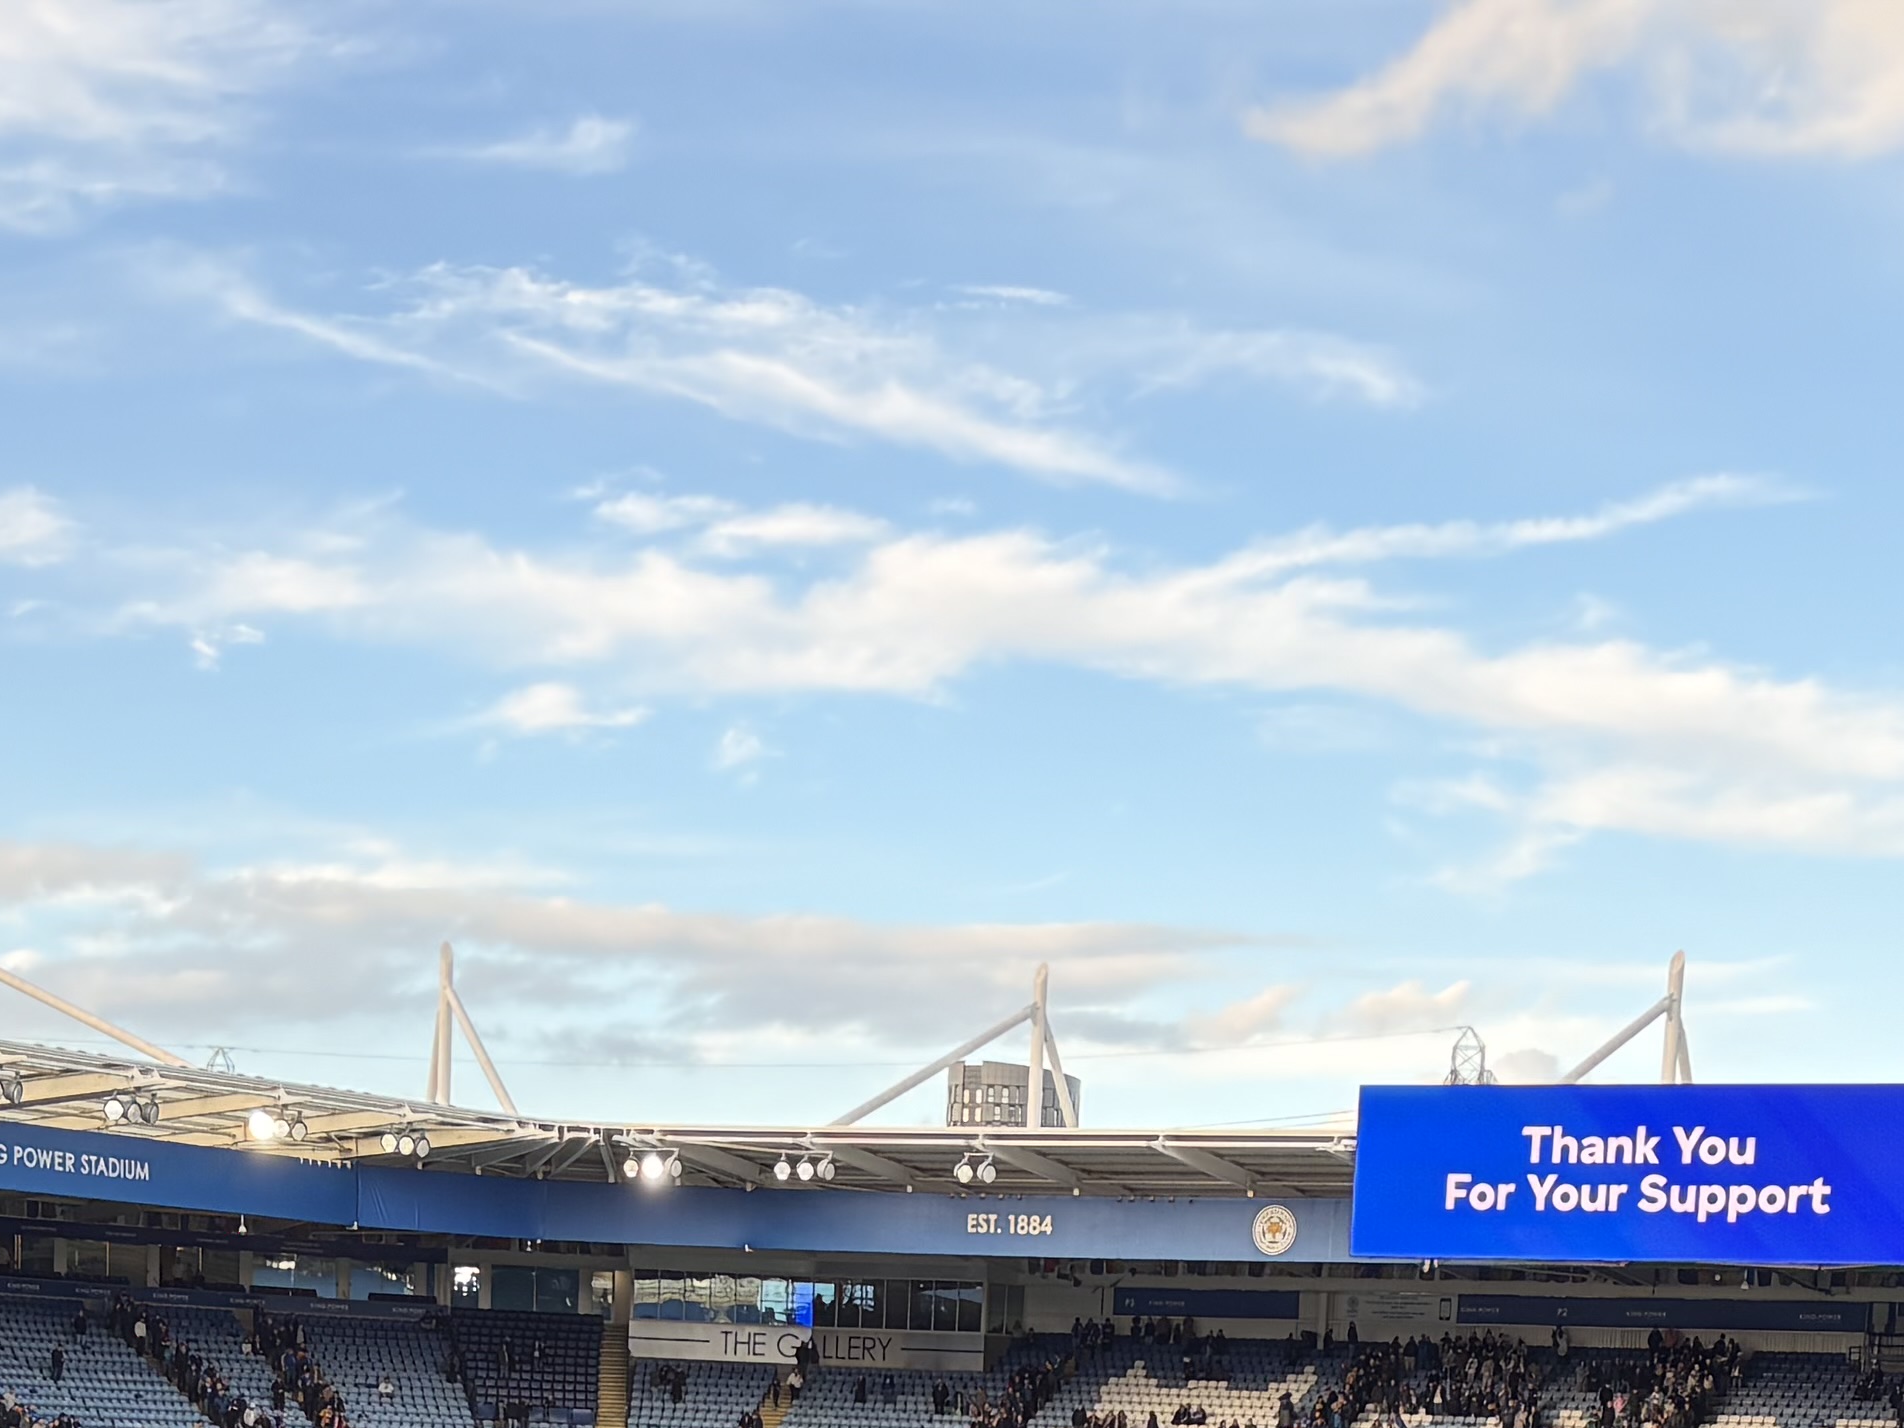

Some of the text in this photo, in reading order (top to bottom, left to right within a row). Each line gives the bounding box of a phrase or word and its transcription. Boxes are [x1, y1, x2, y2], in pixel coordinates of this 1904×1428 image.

[1521, 1125, 1757, 1165] Thank You
[13, 1146, 75, 1173] POWER
[80, 1154, 150, 1181] STADIUM
[1445, 1173, 1832, 1223] For Your Support
[967, 1214, 1053, 1236] EST. 1884
[721, 1330, 765, 1360] THE
